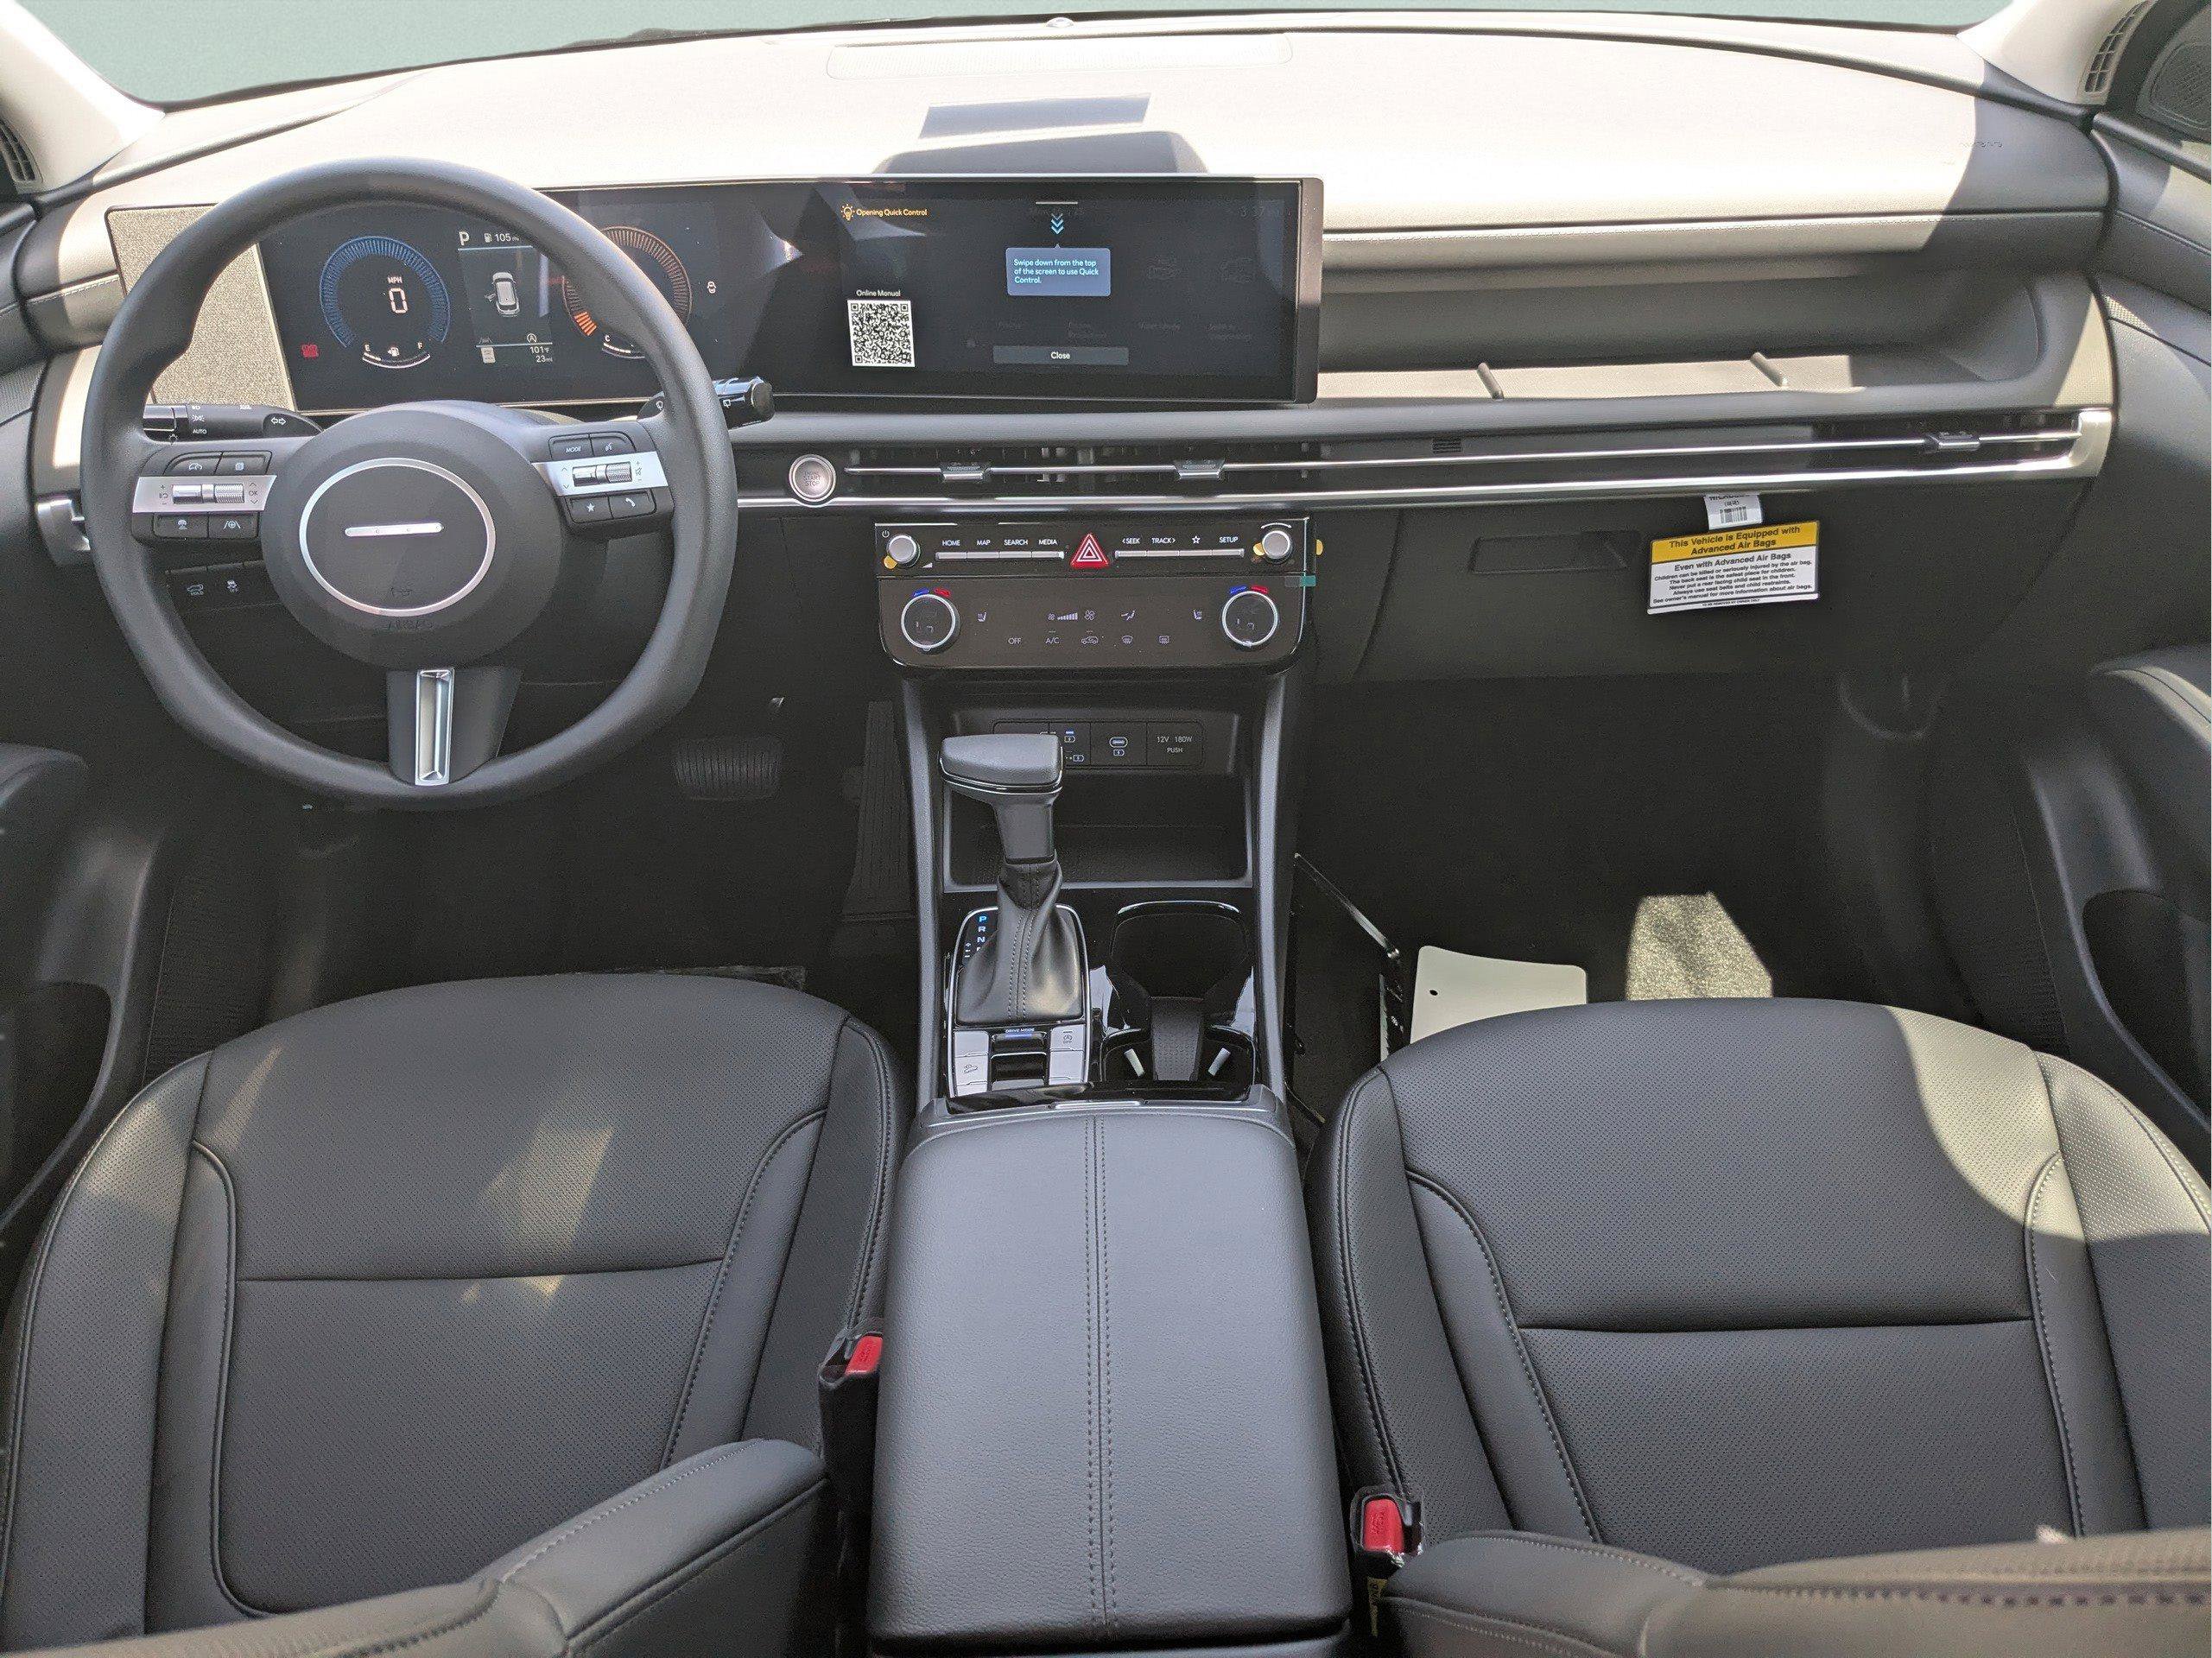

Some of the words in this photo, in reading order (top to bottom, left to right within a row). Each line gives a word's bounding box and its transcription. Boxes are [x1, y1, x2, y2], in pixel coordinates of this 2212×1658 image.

[856, 208, 884, 217] Opening
[459, 231, 470, 246] P
[1013, 258, 1034, 267] Swipe
[1014, 275, 1043, 284] Control.
[389, 288, 409, 313] 0
[1050, 351, 1071, 359] Close
[1691, 536, 1723, 546] Vehicle
[1736, 528, 1779, 541] Equipped
[1781, 526, 1801, 535] with
[1691, 542, 1735, 555] Advanced
[1737, 540, 1750, 549] Air
[1753, 539, 1777, 548] Bags
[1714, 555, 1754, 566] Advanced
